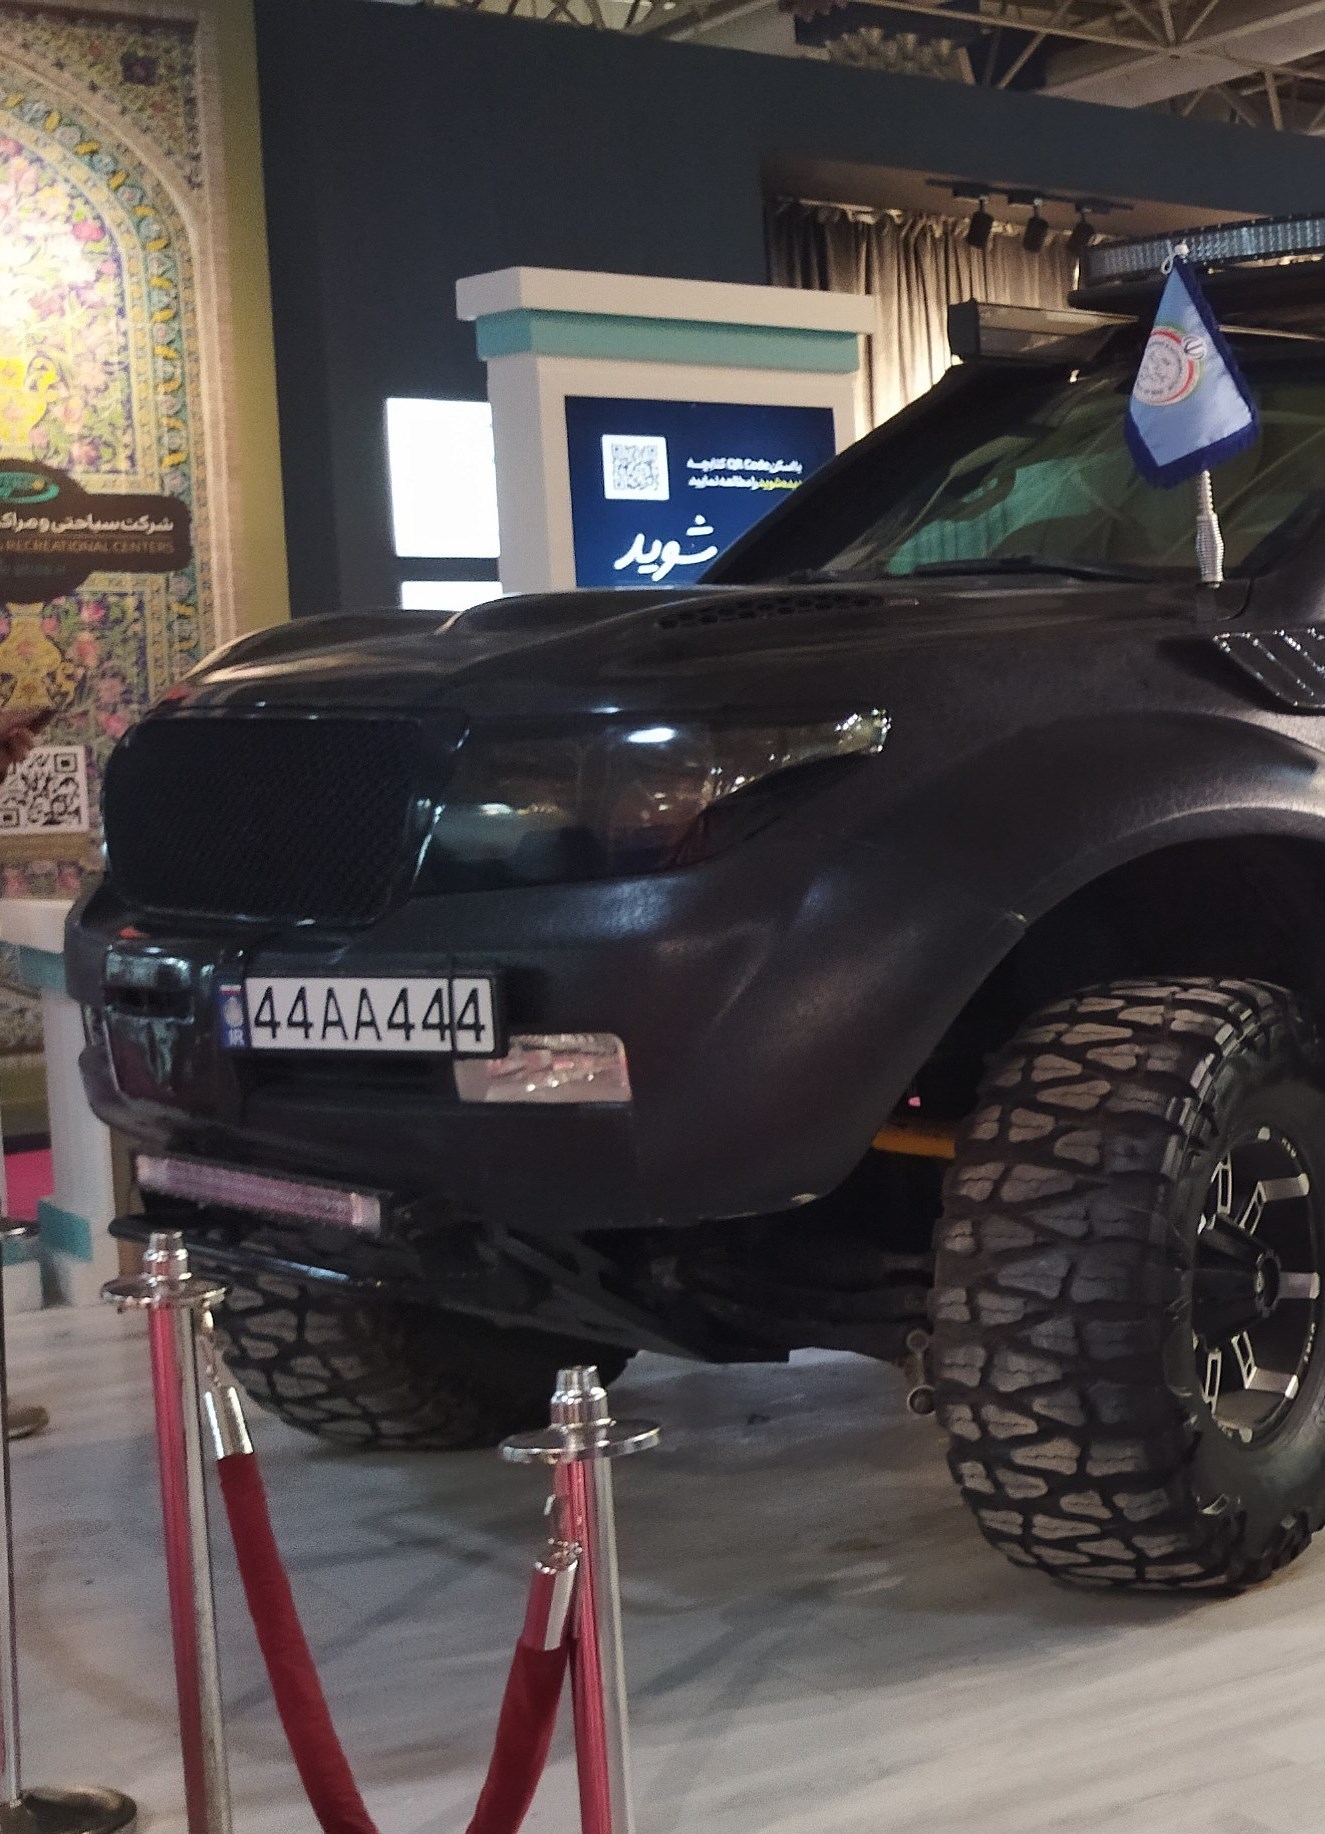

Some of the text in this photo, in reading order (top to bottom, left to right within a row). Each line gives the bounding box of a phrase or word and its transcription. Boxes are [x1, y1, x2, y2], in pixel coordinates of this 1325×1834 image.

[0, 511, 174, 535] شرکت سیاحتی و مراک
[614, 514, 718, 582] شوید
